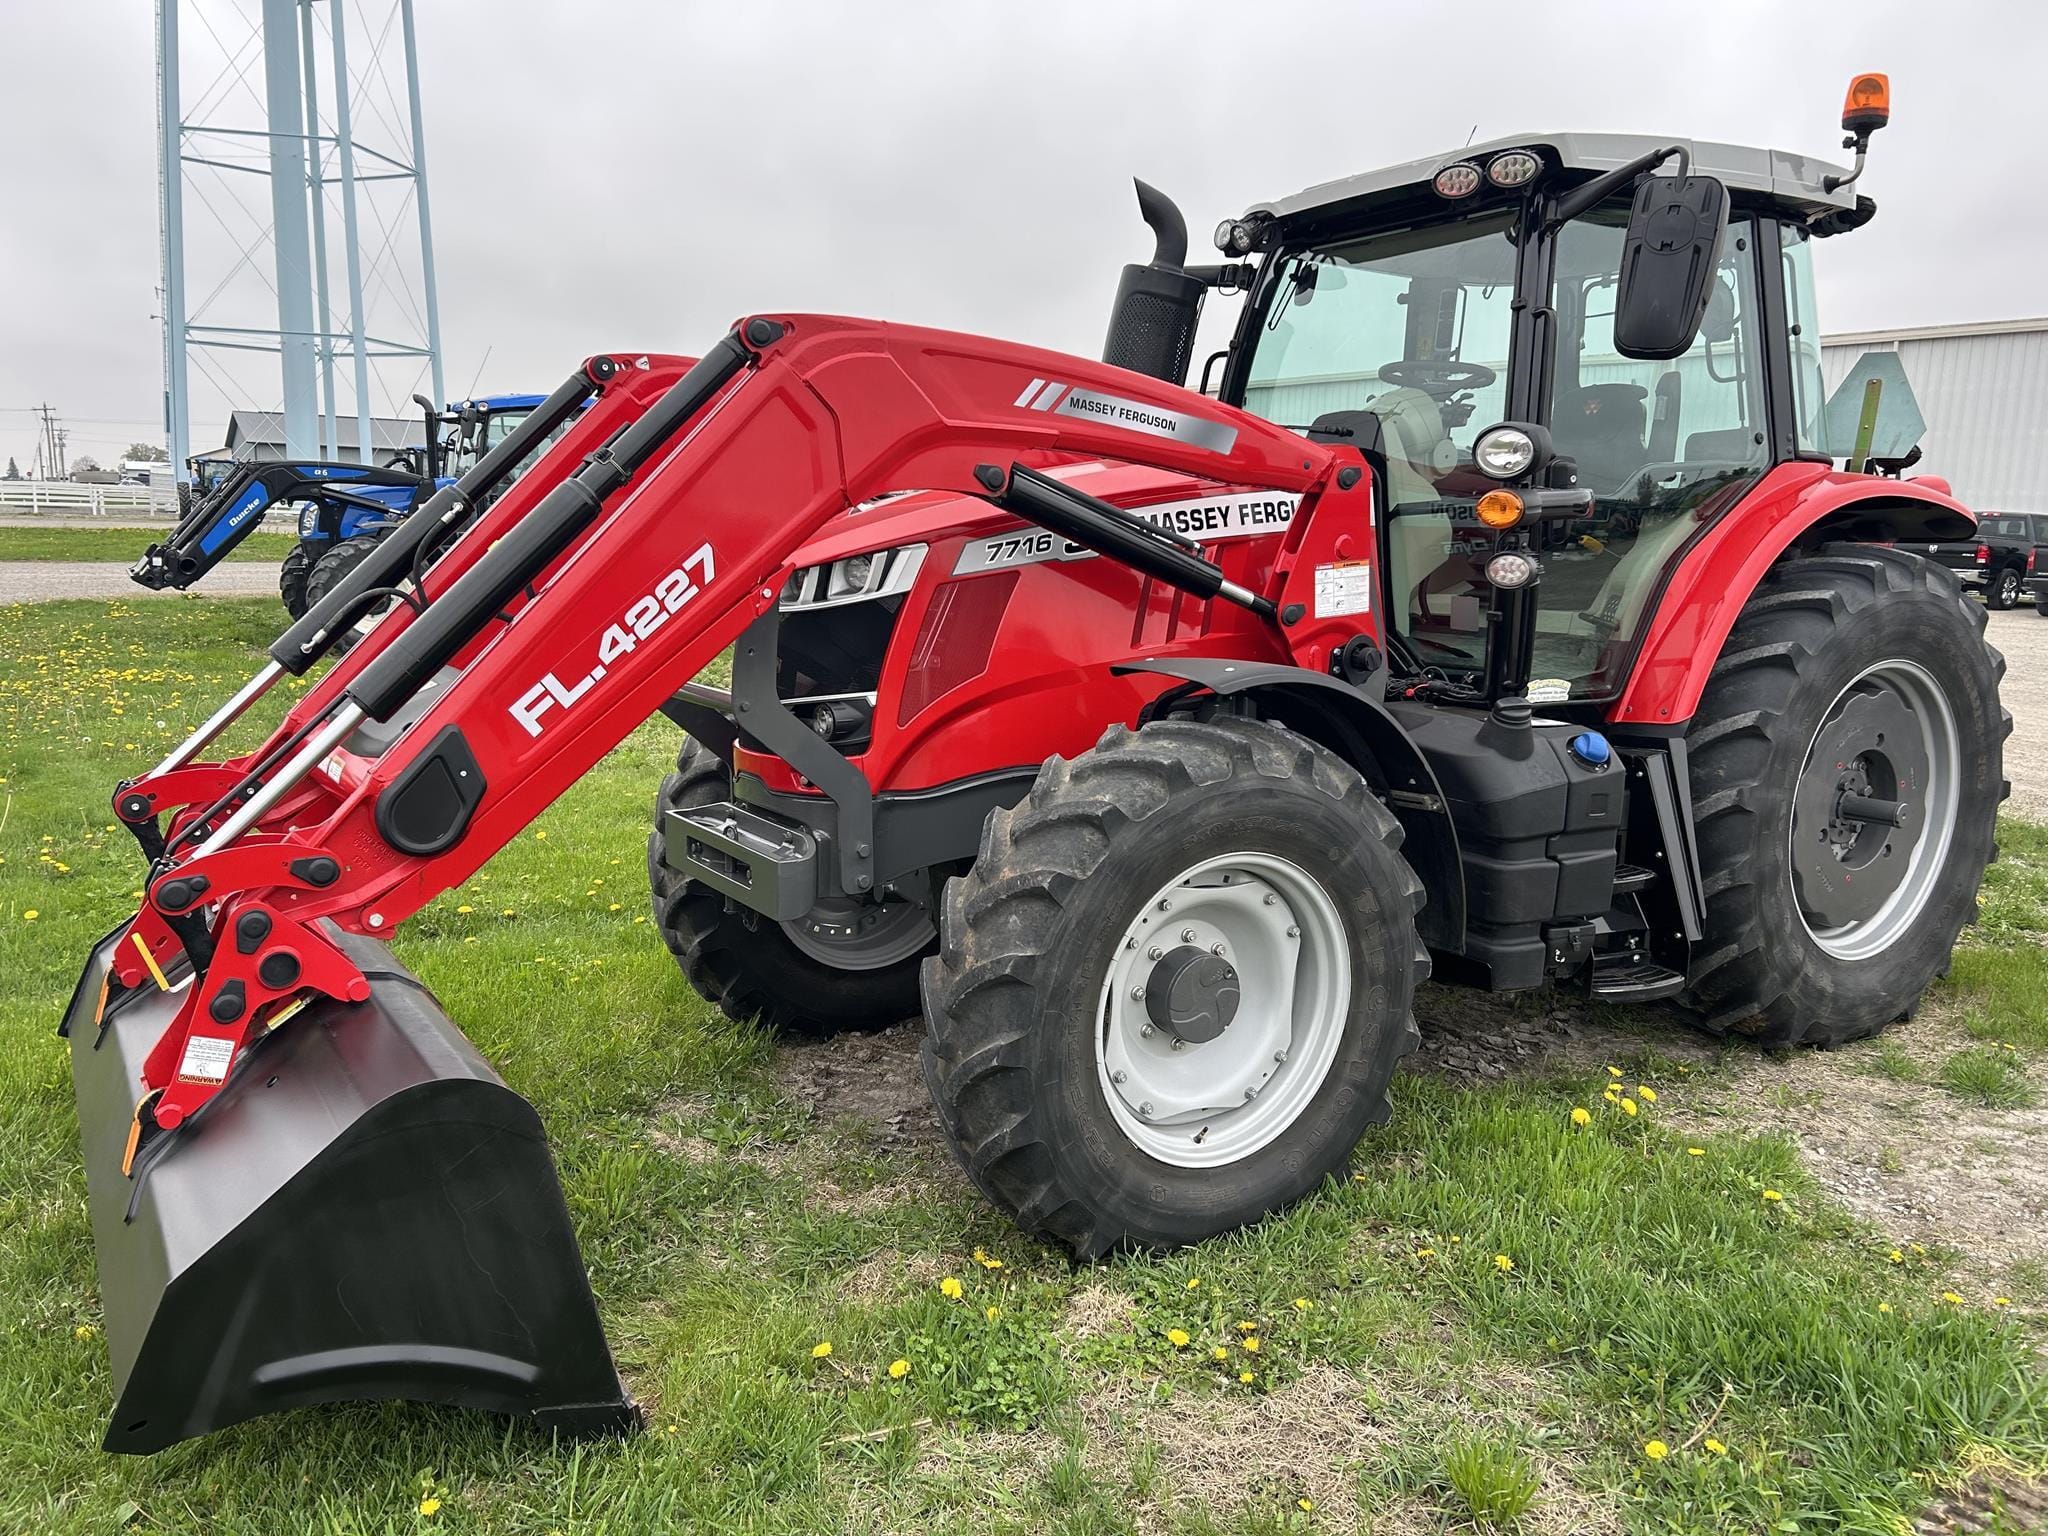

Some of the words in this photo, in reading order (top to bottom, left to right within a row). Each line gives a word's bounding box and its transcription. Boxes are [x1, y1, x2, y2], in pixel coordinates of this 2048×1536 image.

[1069, 397, 1116, 416] MASSEY
[1119, 408, 1177, 432] FERGUSON
[228, 498, 260, 527] Quicke
[985, 532, 1053, 564] 7716
[508, 542, 715, 738] FL.4227
[180, 1074, 216, 1085] WARNING
